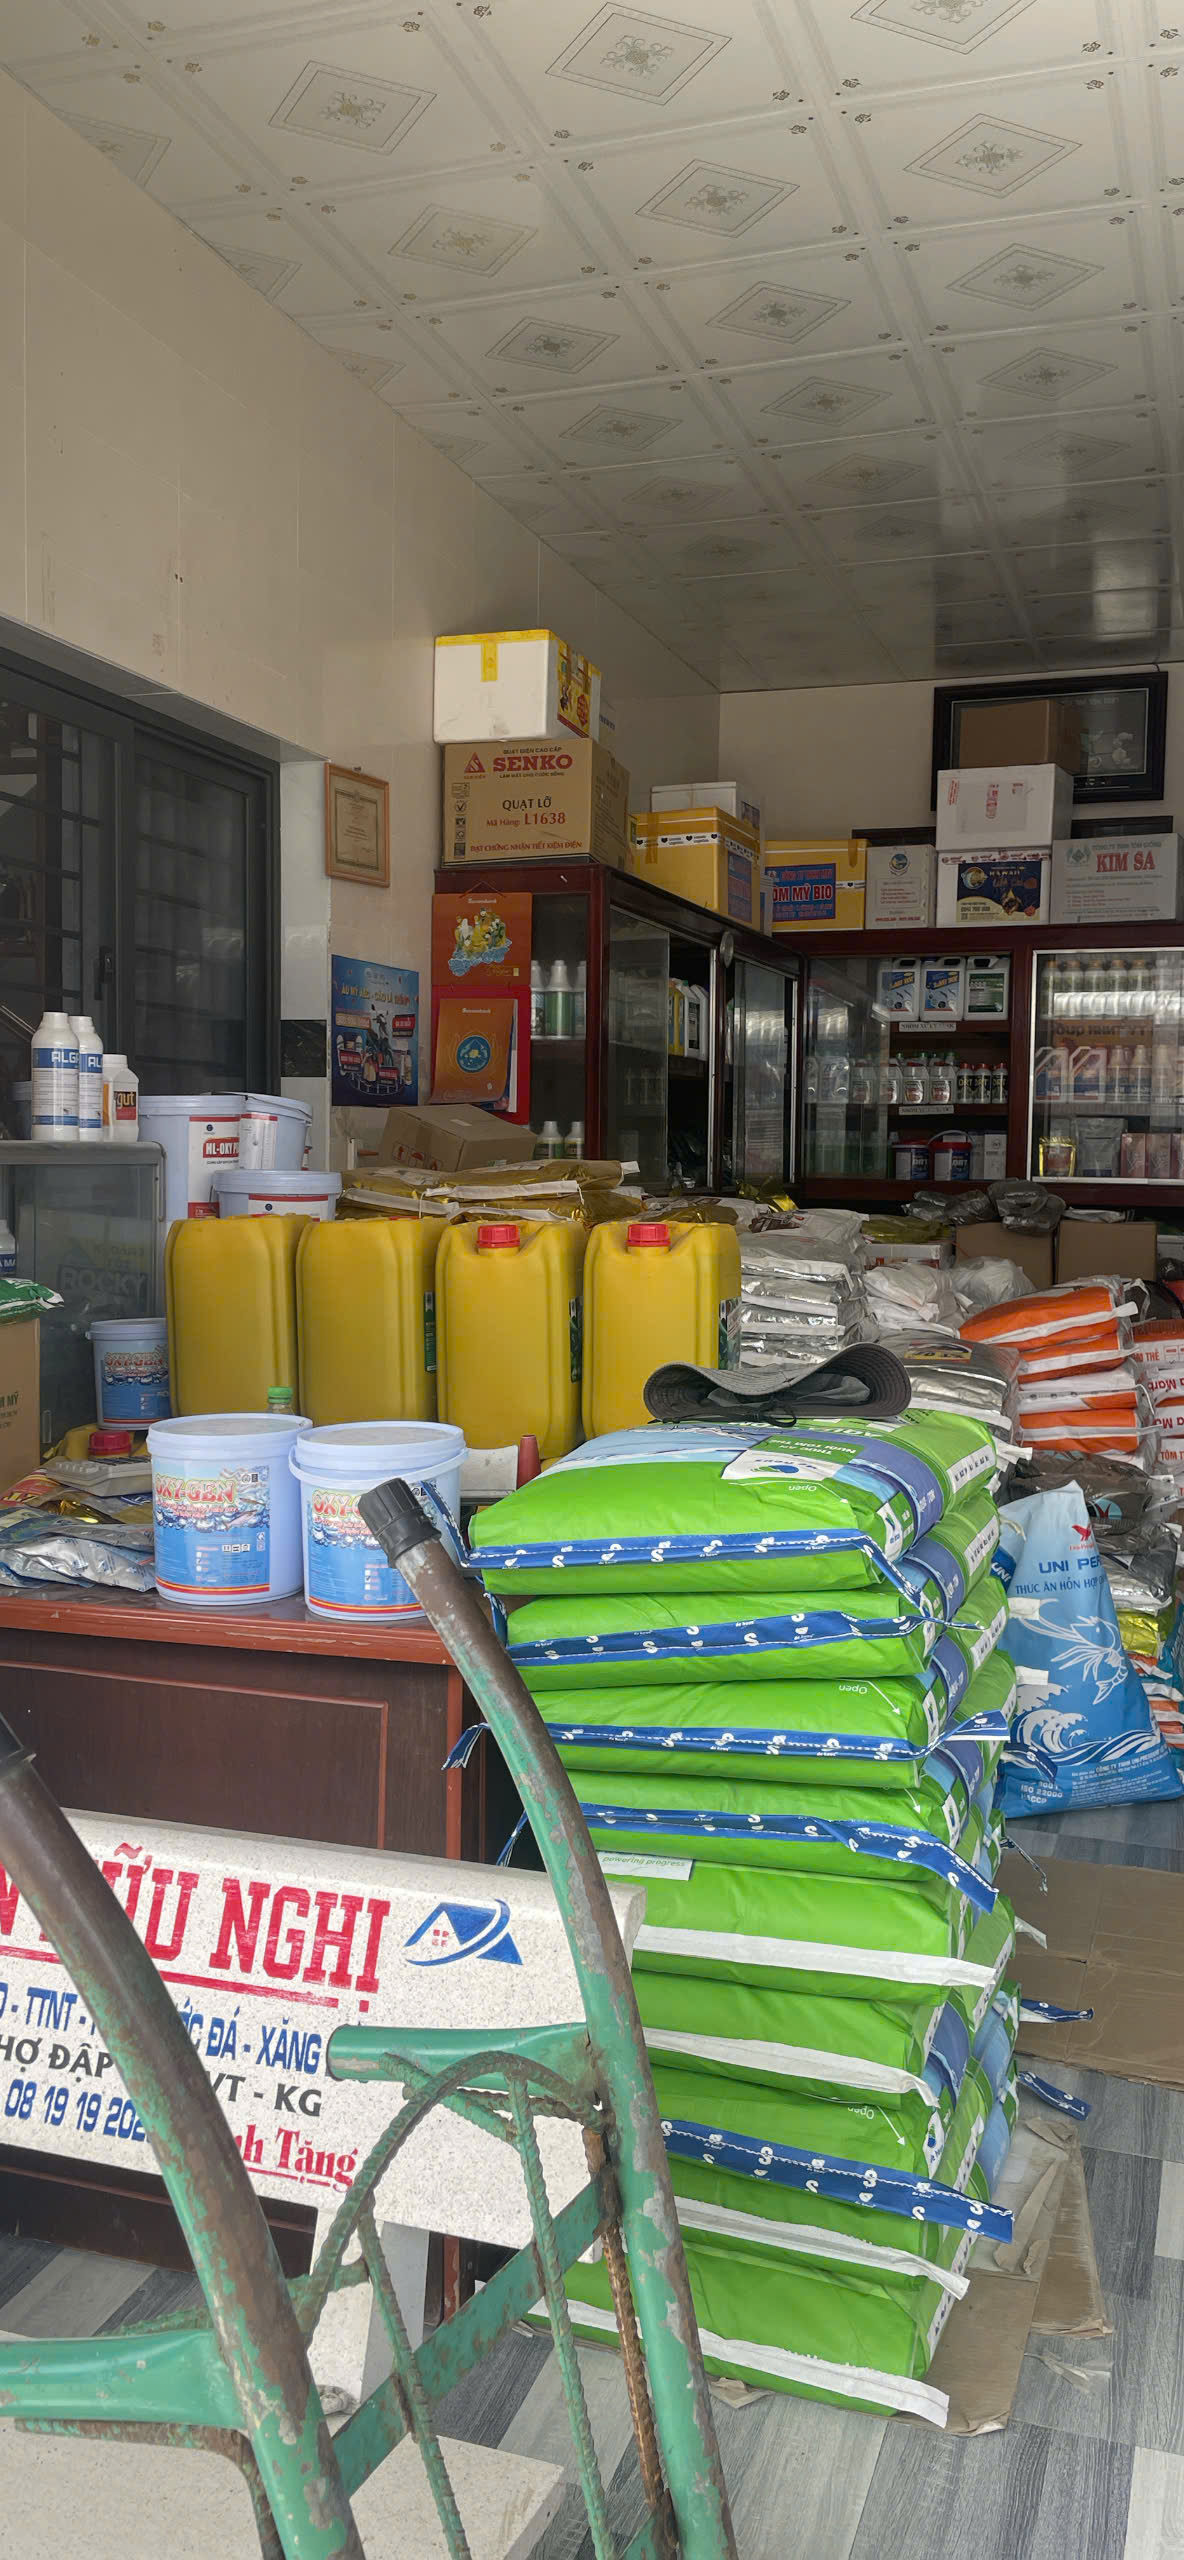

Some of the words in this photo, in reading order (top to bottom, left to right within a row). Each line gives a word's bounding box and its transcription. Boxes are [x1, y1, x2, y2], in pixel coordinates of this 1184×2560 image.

[493, 754, 573, 772] SENKO
[502, 798, 534, 811] QUẠT
[525, 812, 566, 825] L1638
[1096, 851, 1128, 873] KIM
[1132, 850, 1155, 871] SA
[813, 884, 833, 901] BIO
[155, 1475, 237, 1504] OXY-GEN
[788, 1484, 817, 1492] Open
[991, 1562, 1012, 1583] UNI
[1038, 1559, 1069, 1574] UNI
[838, 1684, 868, 1695] Open
[1020, 1784, 1034, 1793] ISO
[1036, 1788, 1064, 1798] 22000
[602, 1855, 644, 1866] powering
[645, 1858, 686, 1867] progress
[93, 1842, 200, 1962] ỮU
[208, 1877, 392, 2013] NGHỊ
[26, 1987, 78, 2032] TTNT
[205, 2005, 241, 2061] ĐÁ
[255, 2016, 322, 2075] XĂNG
[0, 2034, 43, 2073] HỢ
[48, 2042, 115, 2084] ĐẬP
[273, 2083, 323, 2117] KG
[4, 2078, 38, 2120] 08
[44, 2085, 70, 2127] 19
[76, 2091, 102, 2132] 19
[102, 2096, 151, 2143] 202
[275, 2126, 359, 2193] Tặng
